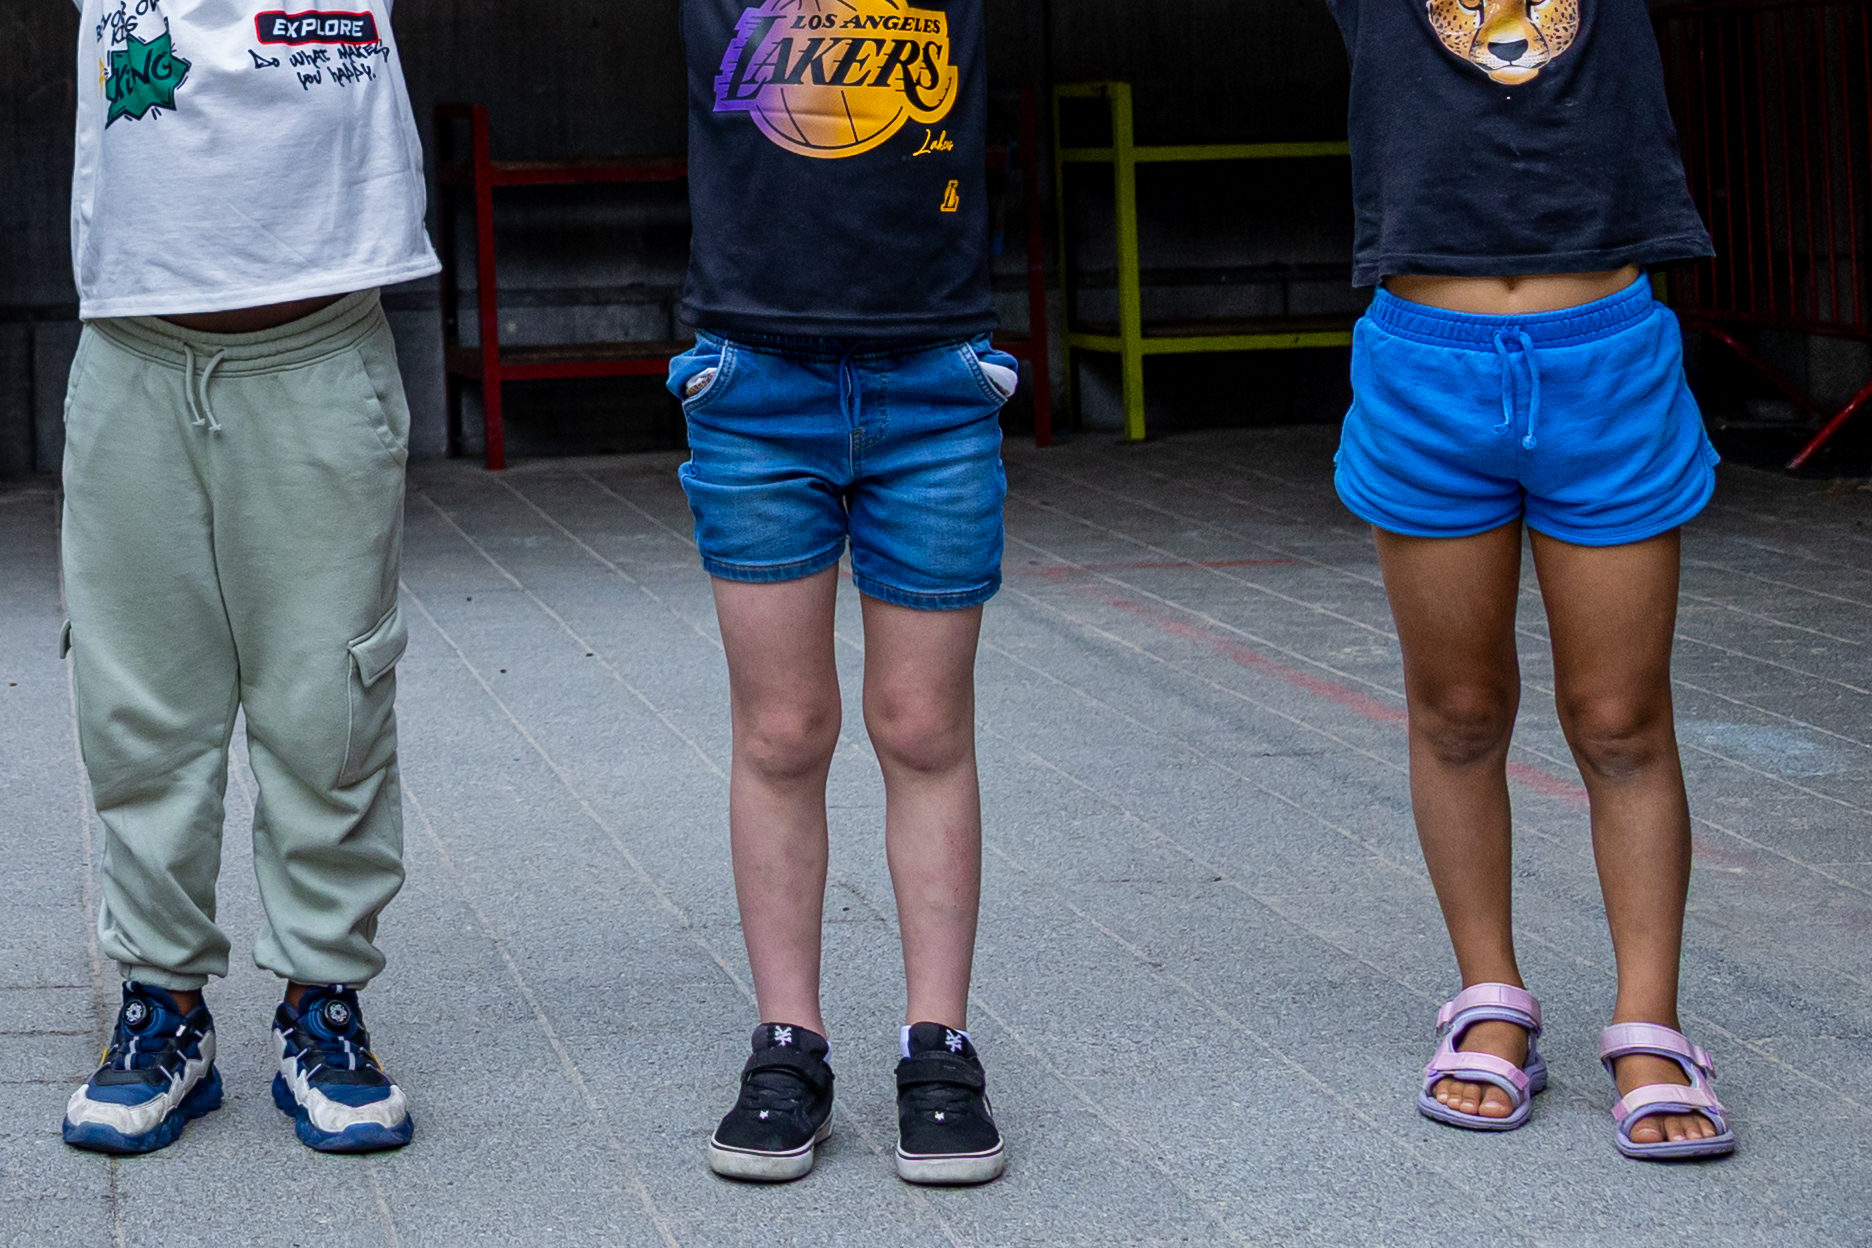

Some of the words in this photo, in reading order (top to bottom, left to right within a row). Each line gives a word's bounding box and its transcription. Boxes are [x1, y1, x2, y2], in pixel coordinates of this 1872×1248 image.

[272, 17, 364, 38] EXPLORE
[791, 13, 837, 30] LOS
[839, 13, 941, 35] ANGELES
[720, 15, 952, 112] LAKERS
